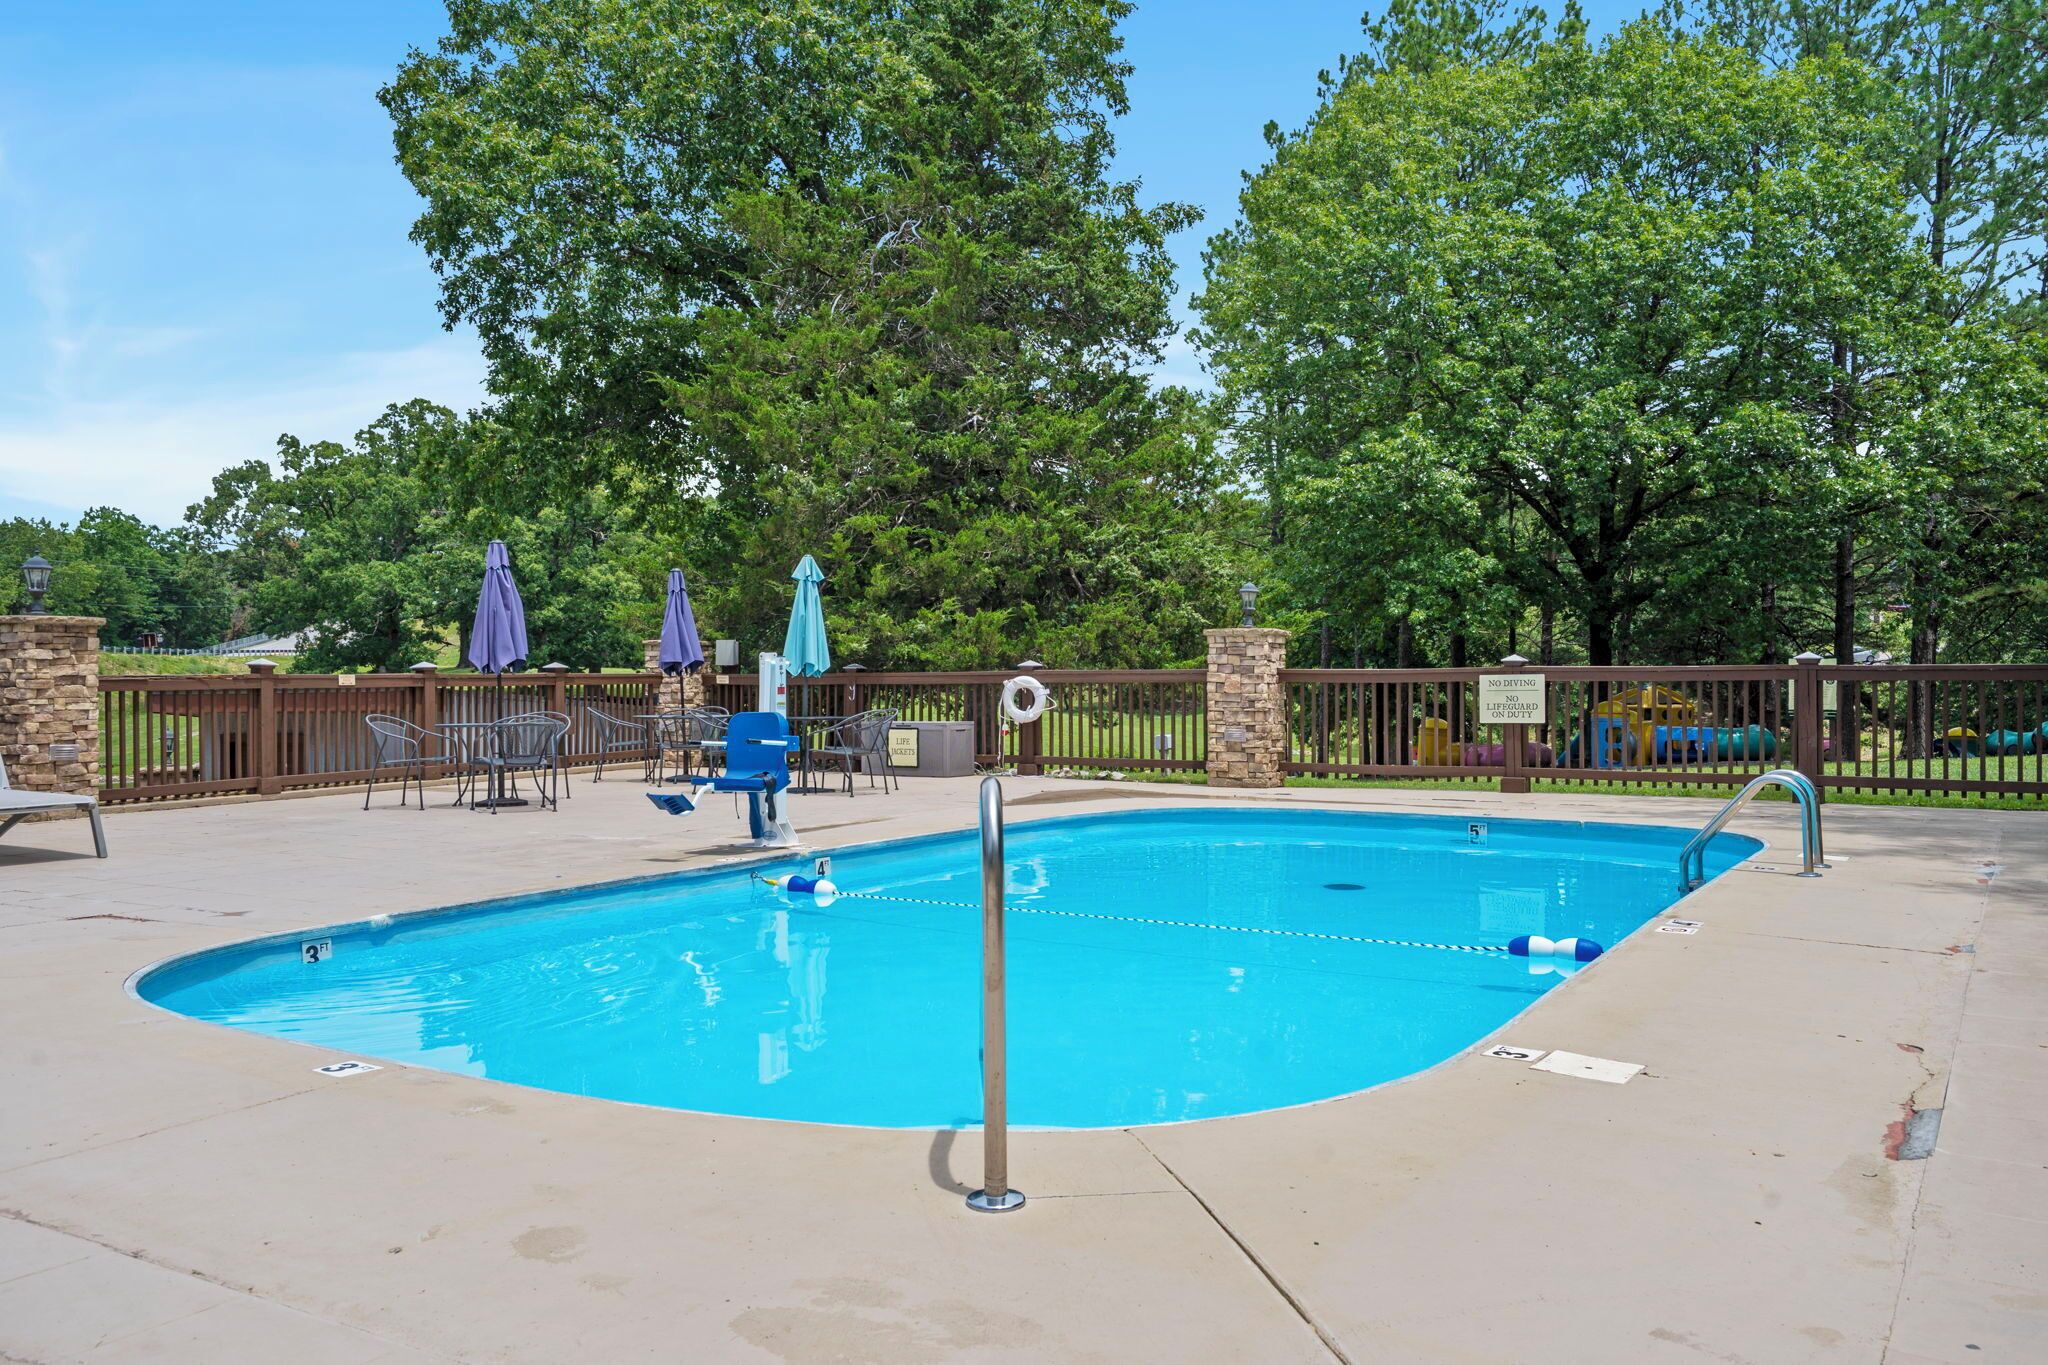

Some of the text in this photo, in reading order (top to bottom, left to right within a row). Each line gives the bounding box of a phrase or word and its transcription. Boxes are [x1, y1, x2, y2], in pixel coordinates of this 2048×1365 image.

[1486, 703, 1539, 711] LIFEGUARD
[1491, 711, 1533, 719] ON DUTY
[896, 737, 911, 746] LIFE
[1470, 824, 1480, 836] 5
[817, 860, 825, 875] 4
[305, 943, 329, 964] 3 FT
[1492, 1051, 1529, 1059] 3
[321, 1063, 359, 1073] 3
